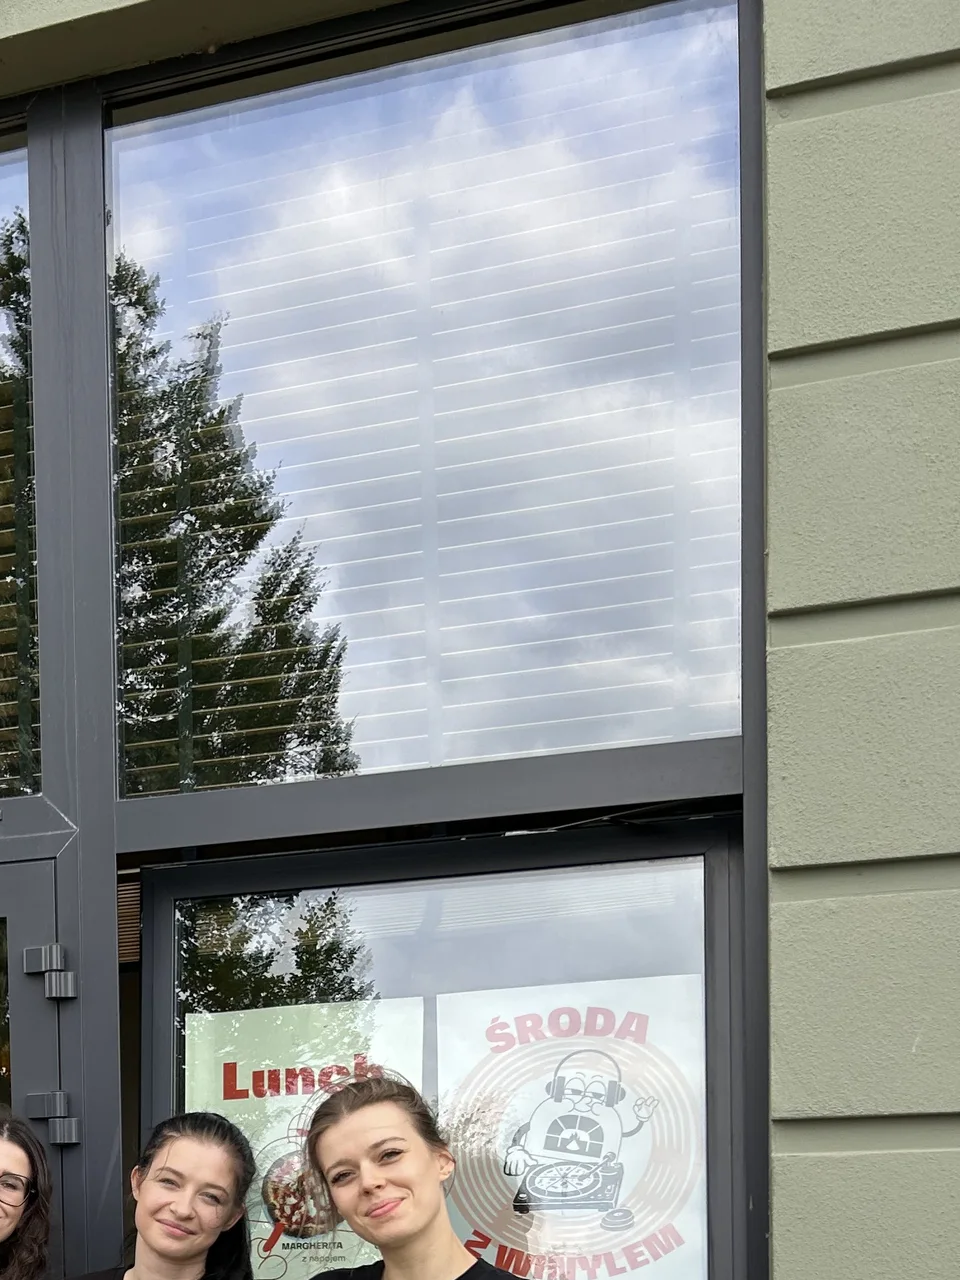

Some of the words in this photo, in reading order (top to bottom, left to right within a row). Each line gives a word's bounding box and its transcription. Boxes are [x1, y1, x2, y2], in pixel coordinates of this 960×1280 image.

[485, 1006, 650, 1054] ŚRODA
[281, 1241, 344, 1251] MARGHERITA
[463, 1229, 493, 1260] Z
